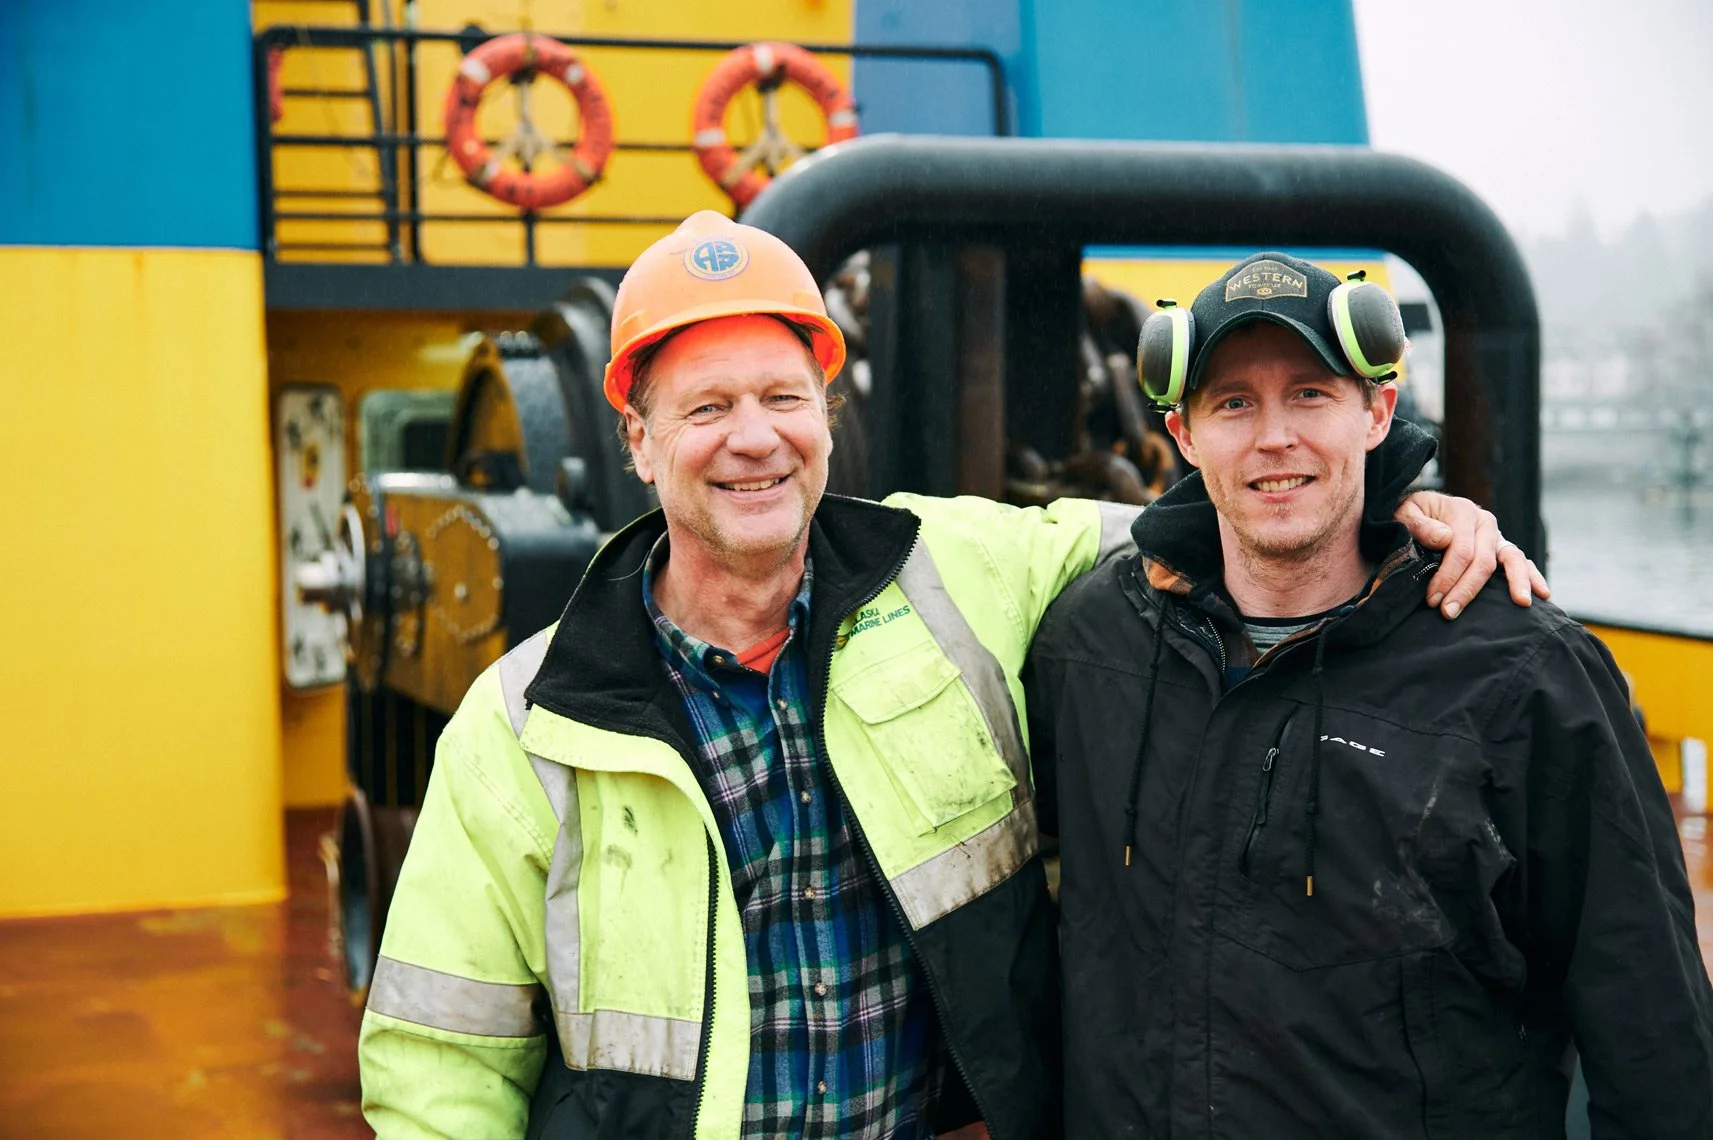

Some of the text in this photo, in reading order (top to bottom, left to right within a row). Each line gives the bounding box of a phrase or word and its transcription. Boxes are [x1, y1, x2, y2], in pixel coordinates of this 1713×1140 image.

[1229, 272, 1304, 292] WESTERN
[850, 604, 911, 637] MARINE LINES
